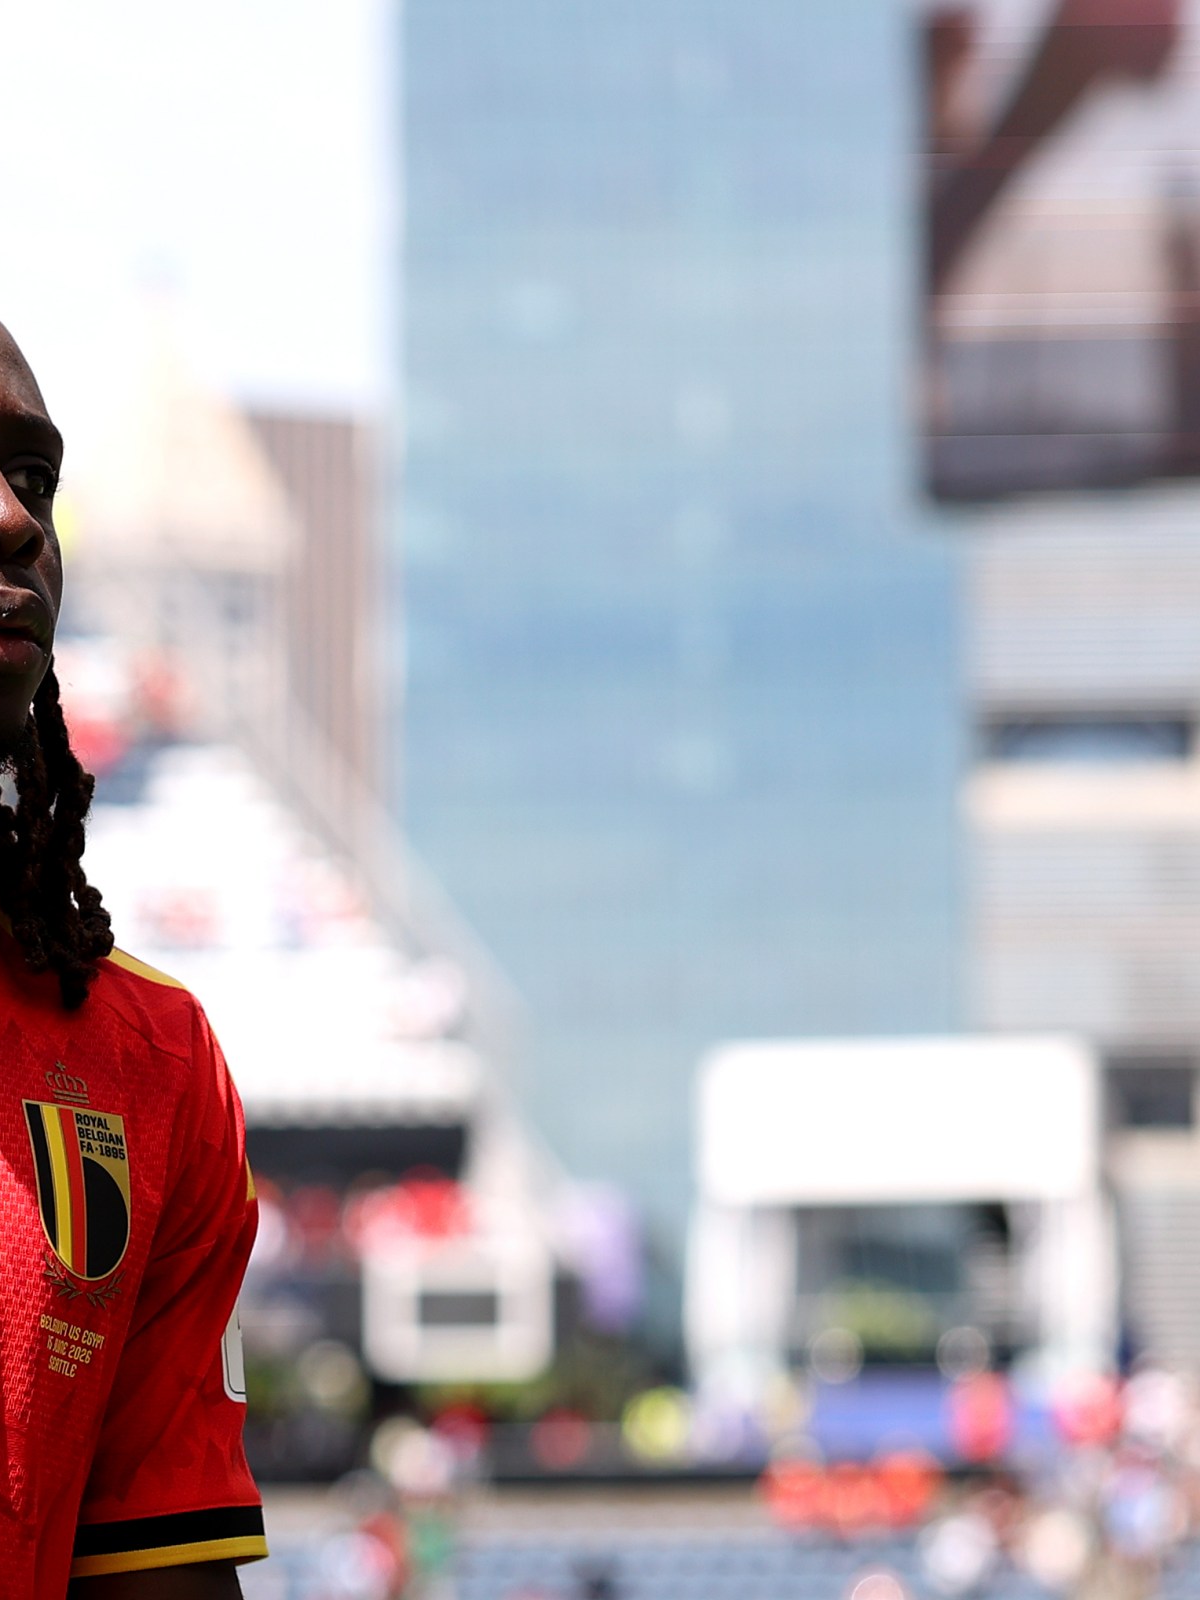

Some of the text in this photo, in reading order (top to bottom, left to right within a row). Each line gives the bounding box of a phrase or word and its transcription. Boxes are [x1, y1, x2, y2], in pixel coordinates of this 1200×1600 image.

[75, 1113, 110, 1130] ROYAL
[78, 1127, 124, 1146] BELGIAN
[82, 1330, 104, 1350] EGYPT
[68, 1345, 91, 1364] 2026
[48, 1355, 77, 1378] SEATTLE
